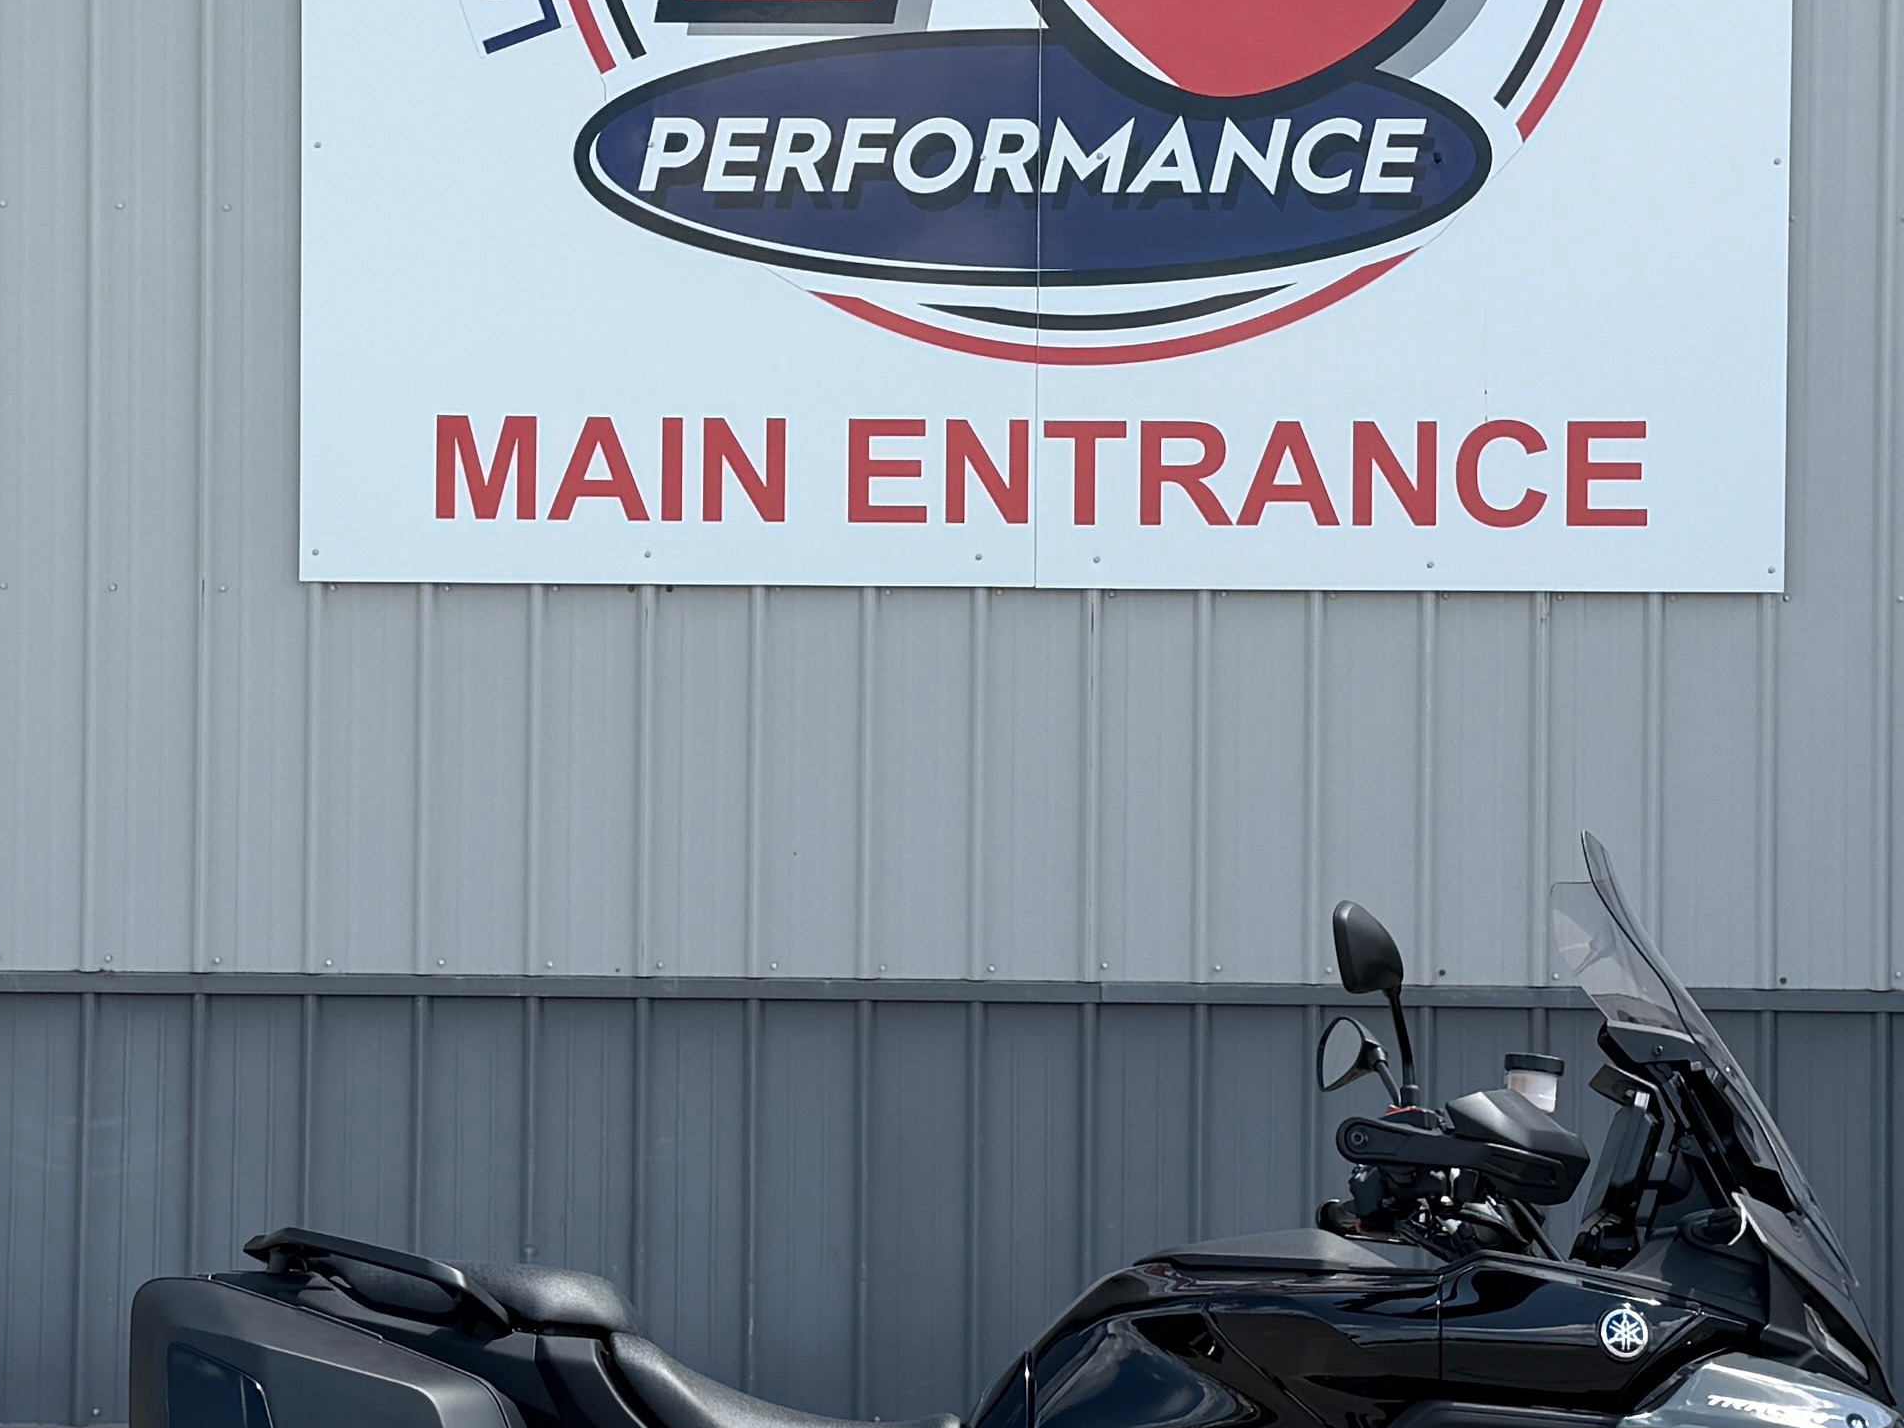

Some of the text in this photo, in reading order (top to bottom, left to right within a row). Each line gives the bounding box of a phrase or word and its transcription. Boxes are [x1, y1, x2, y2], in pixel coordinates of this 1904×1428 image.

[638, 115, 1427, 195] PERFORMANCE
[435, 414, 1648, 528] MAIN ENTRANCE
